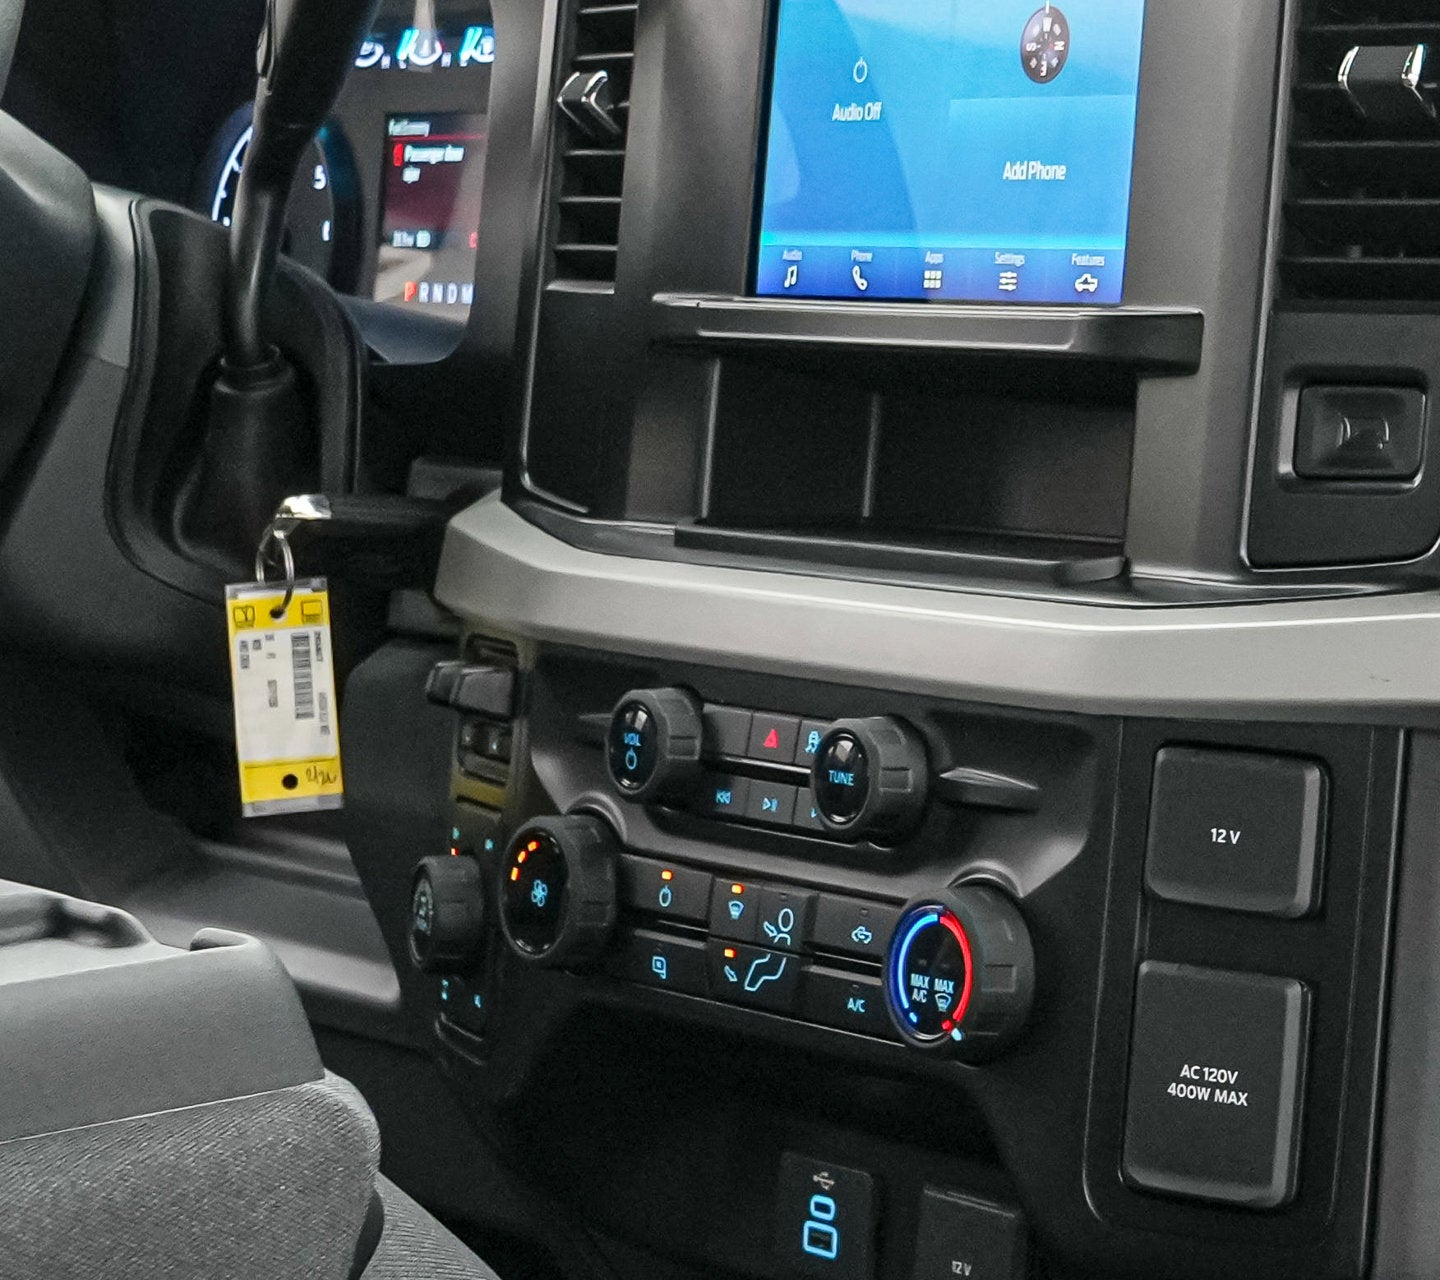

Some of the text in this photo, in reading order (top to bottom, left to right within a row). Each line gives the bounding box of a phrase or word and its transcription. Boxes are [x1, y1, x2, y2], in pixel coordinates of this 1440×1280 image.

[832, 102, 883, 121] Audio Off
[1002, 160, 1067, 180] Add Phone
[828, 769, 855, 787] TUNE
[1210, 828, 1241, 845] 12 V
[910, 973, 955, 994] MAX MAX
[847, 997, 866, 1013] A/C
[911, 988, 928, 1003] A/C
[1180, 1064, 1239, 1085] AC 120V
[1167, 1082, 1249, 1107] 400W MAX
